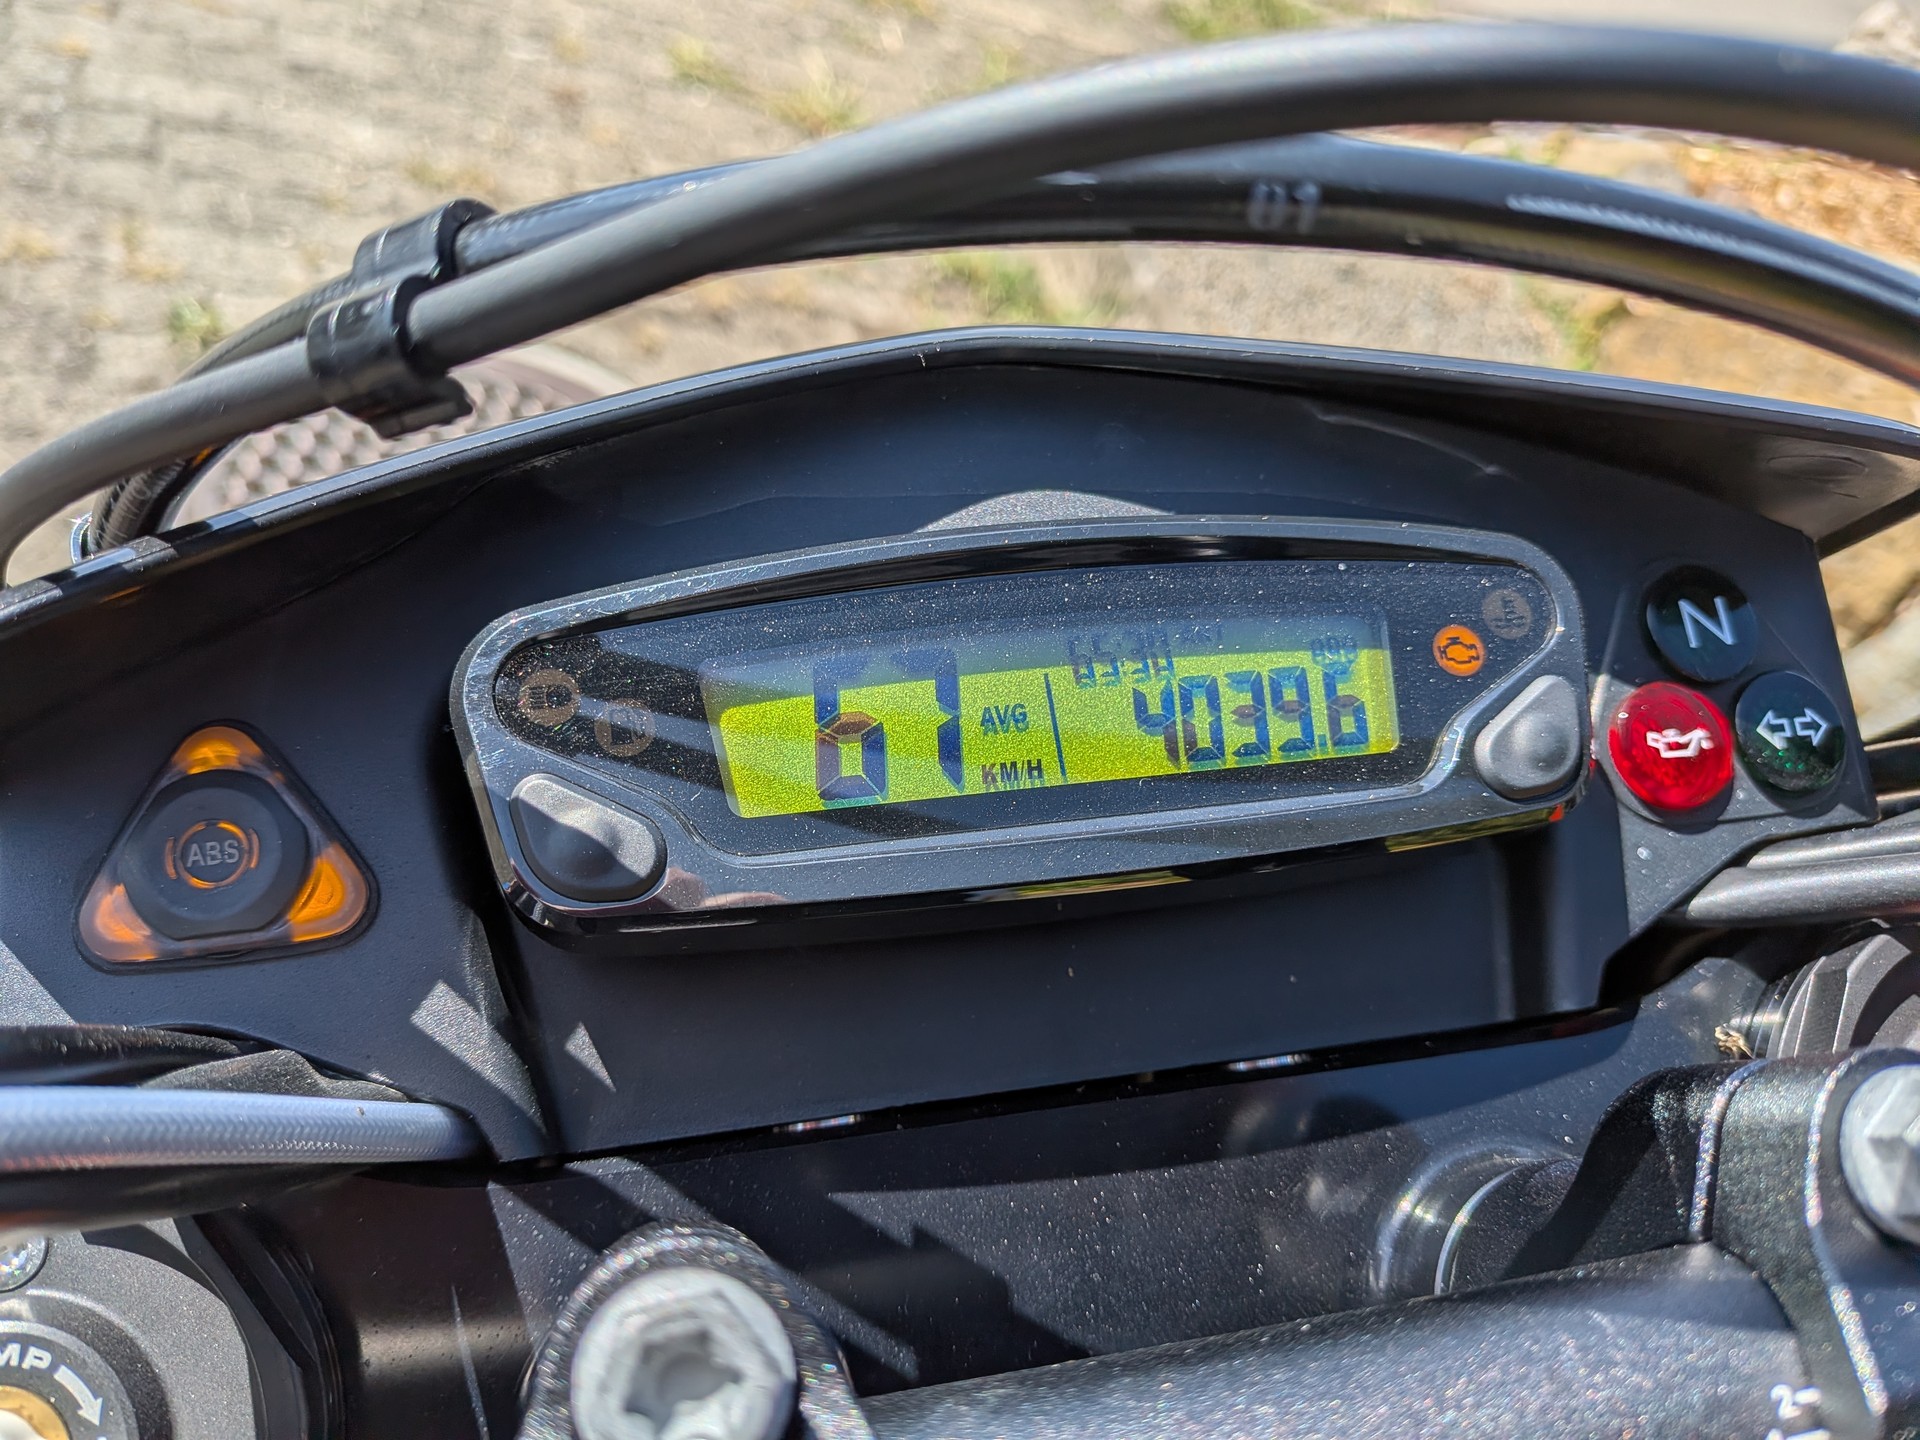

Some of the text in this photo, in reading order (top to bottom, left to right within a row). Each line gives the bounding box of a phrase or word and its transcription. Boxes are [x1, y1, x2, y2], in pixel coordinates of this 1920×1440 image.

[1677, 594, 1738, 649] N
[813, 650, 967, 806] 67
[980, 703, 1029, 732] AVG
[981, 758, 1044, 787] KM/H
[186, 839, 240, 868] ABS
